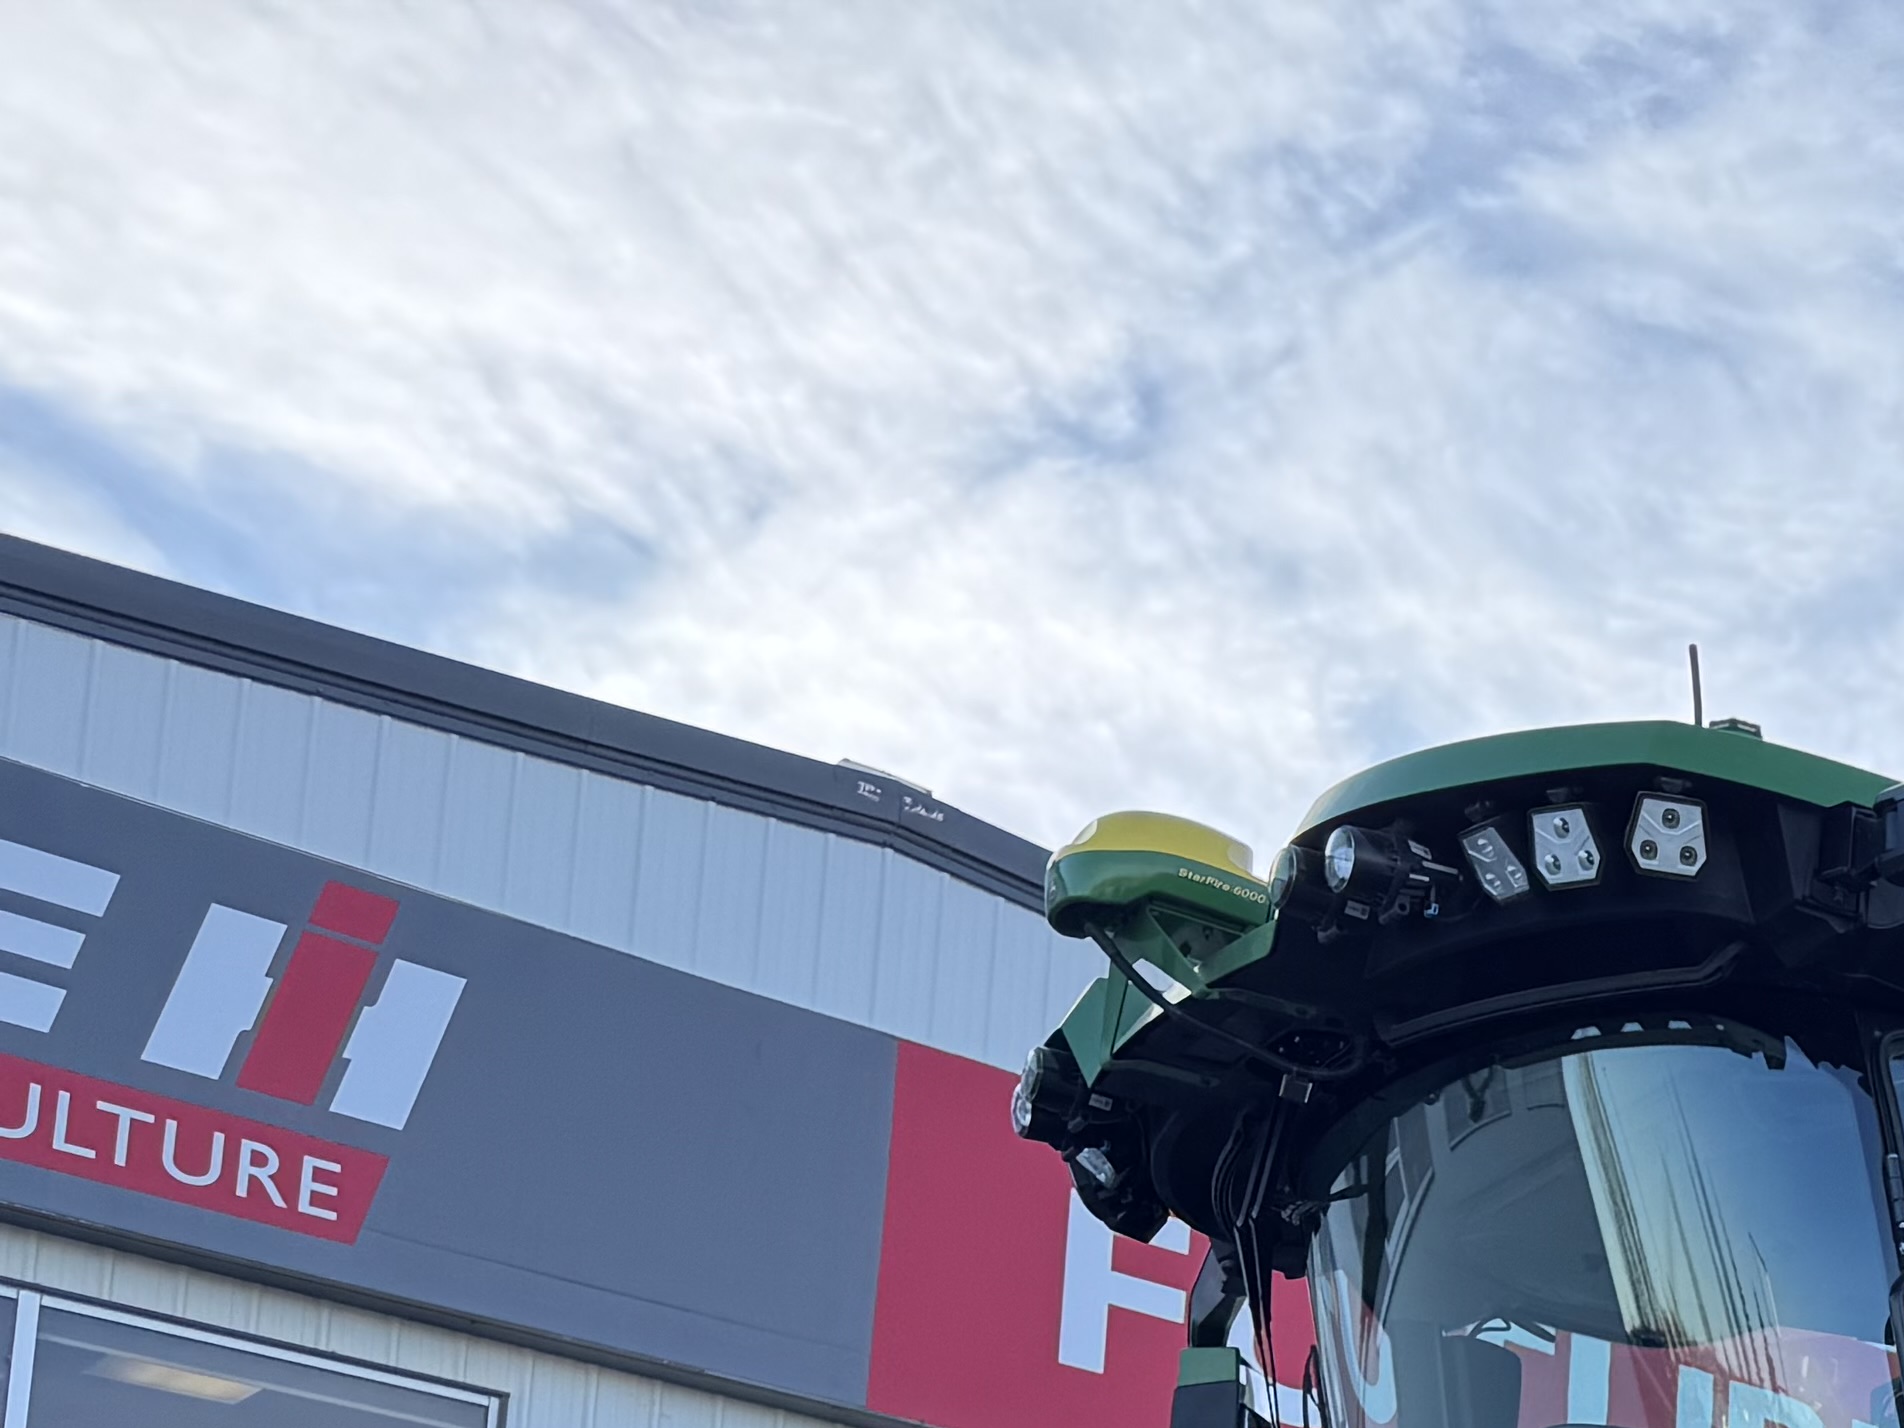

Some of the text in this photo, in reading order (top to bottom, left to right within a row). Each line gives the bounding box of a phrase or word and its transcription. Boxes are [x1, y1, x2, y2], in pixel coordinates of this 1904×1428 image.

[1178, 867, 1266, 904] StarFire 6000
[0, 1082, 342, 1221] ULTURE
